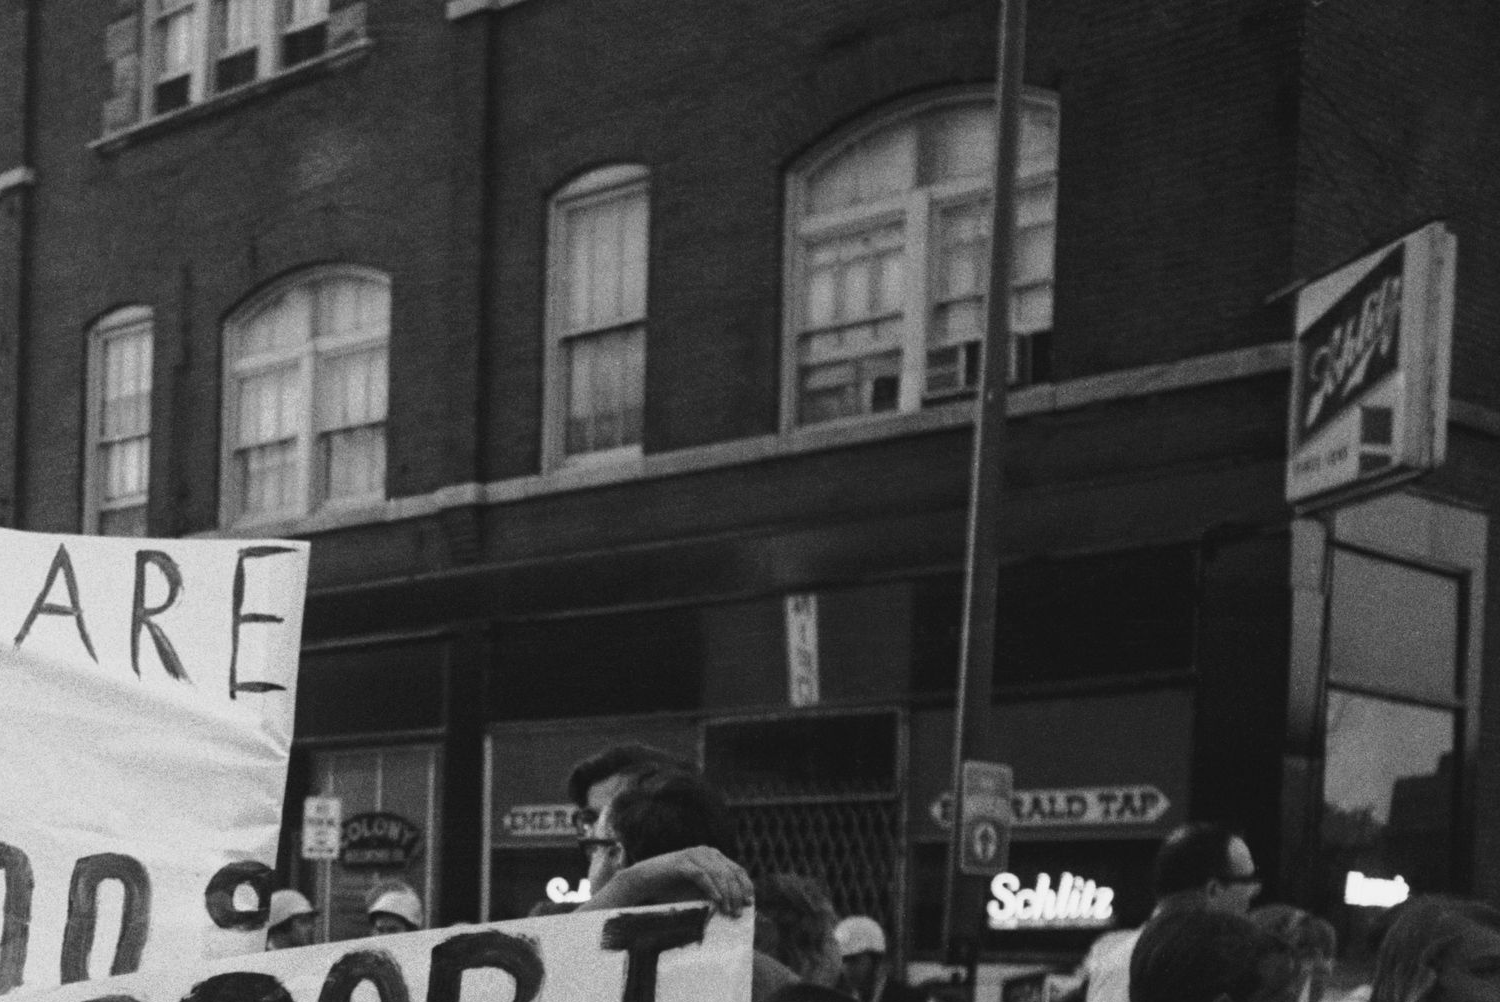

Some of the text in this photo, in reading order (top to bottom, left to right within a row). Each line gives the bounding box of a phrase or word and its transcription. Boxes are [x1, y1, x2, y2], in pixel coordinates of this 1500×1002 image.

[14, 543, 300, 700] ARE
[1097, 791, 1160, 817] TAP
[987, 871, 1114, 923] Schlitz
